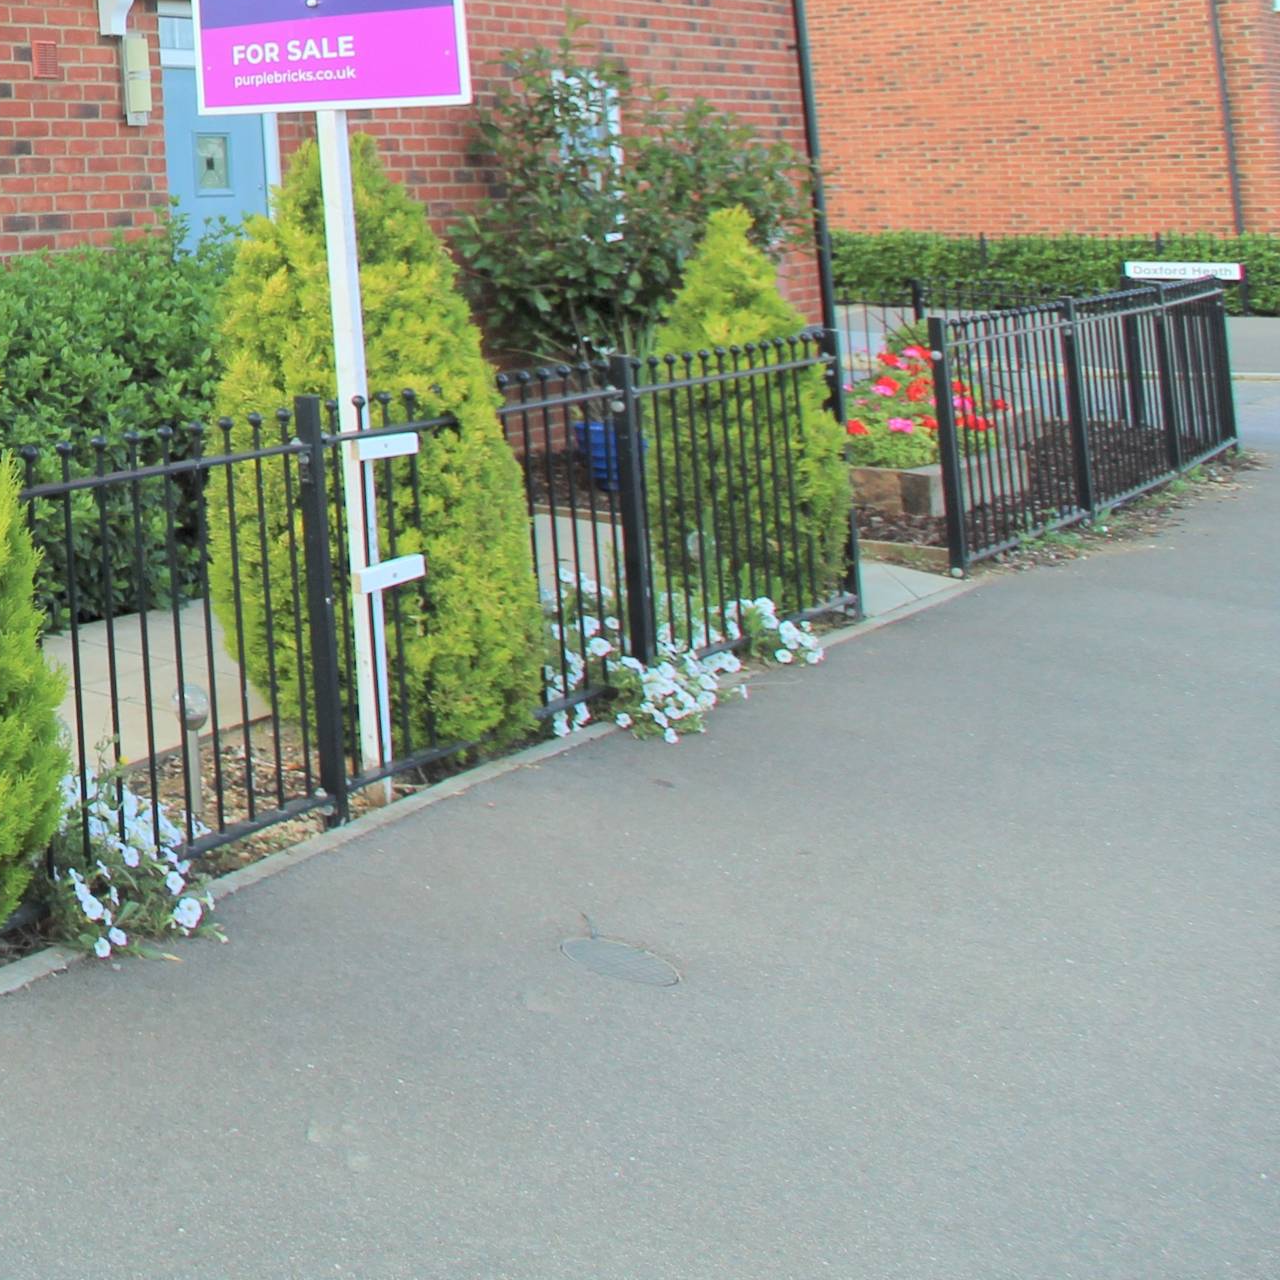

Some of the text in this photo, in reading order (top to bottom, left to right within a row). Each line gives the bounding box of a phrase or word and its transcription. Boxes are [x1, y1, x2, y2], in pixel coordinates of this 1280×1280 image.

[232, 35, 355, 65] FOR SALE
[234, 66, 356, 88] purplebricks.co.uk
[1192, 267, 1233, 277] Heath
